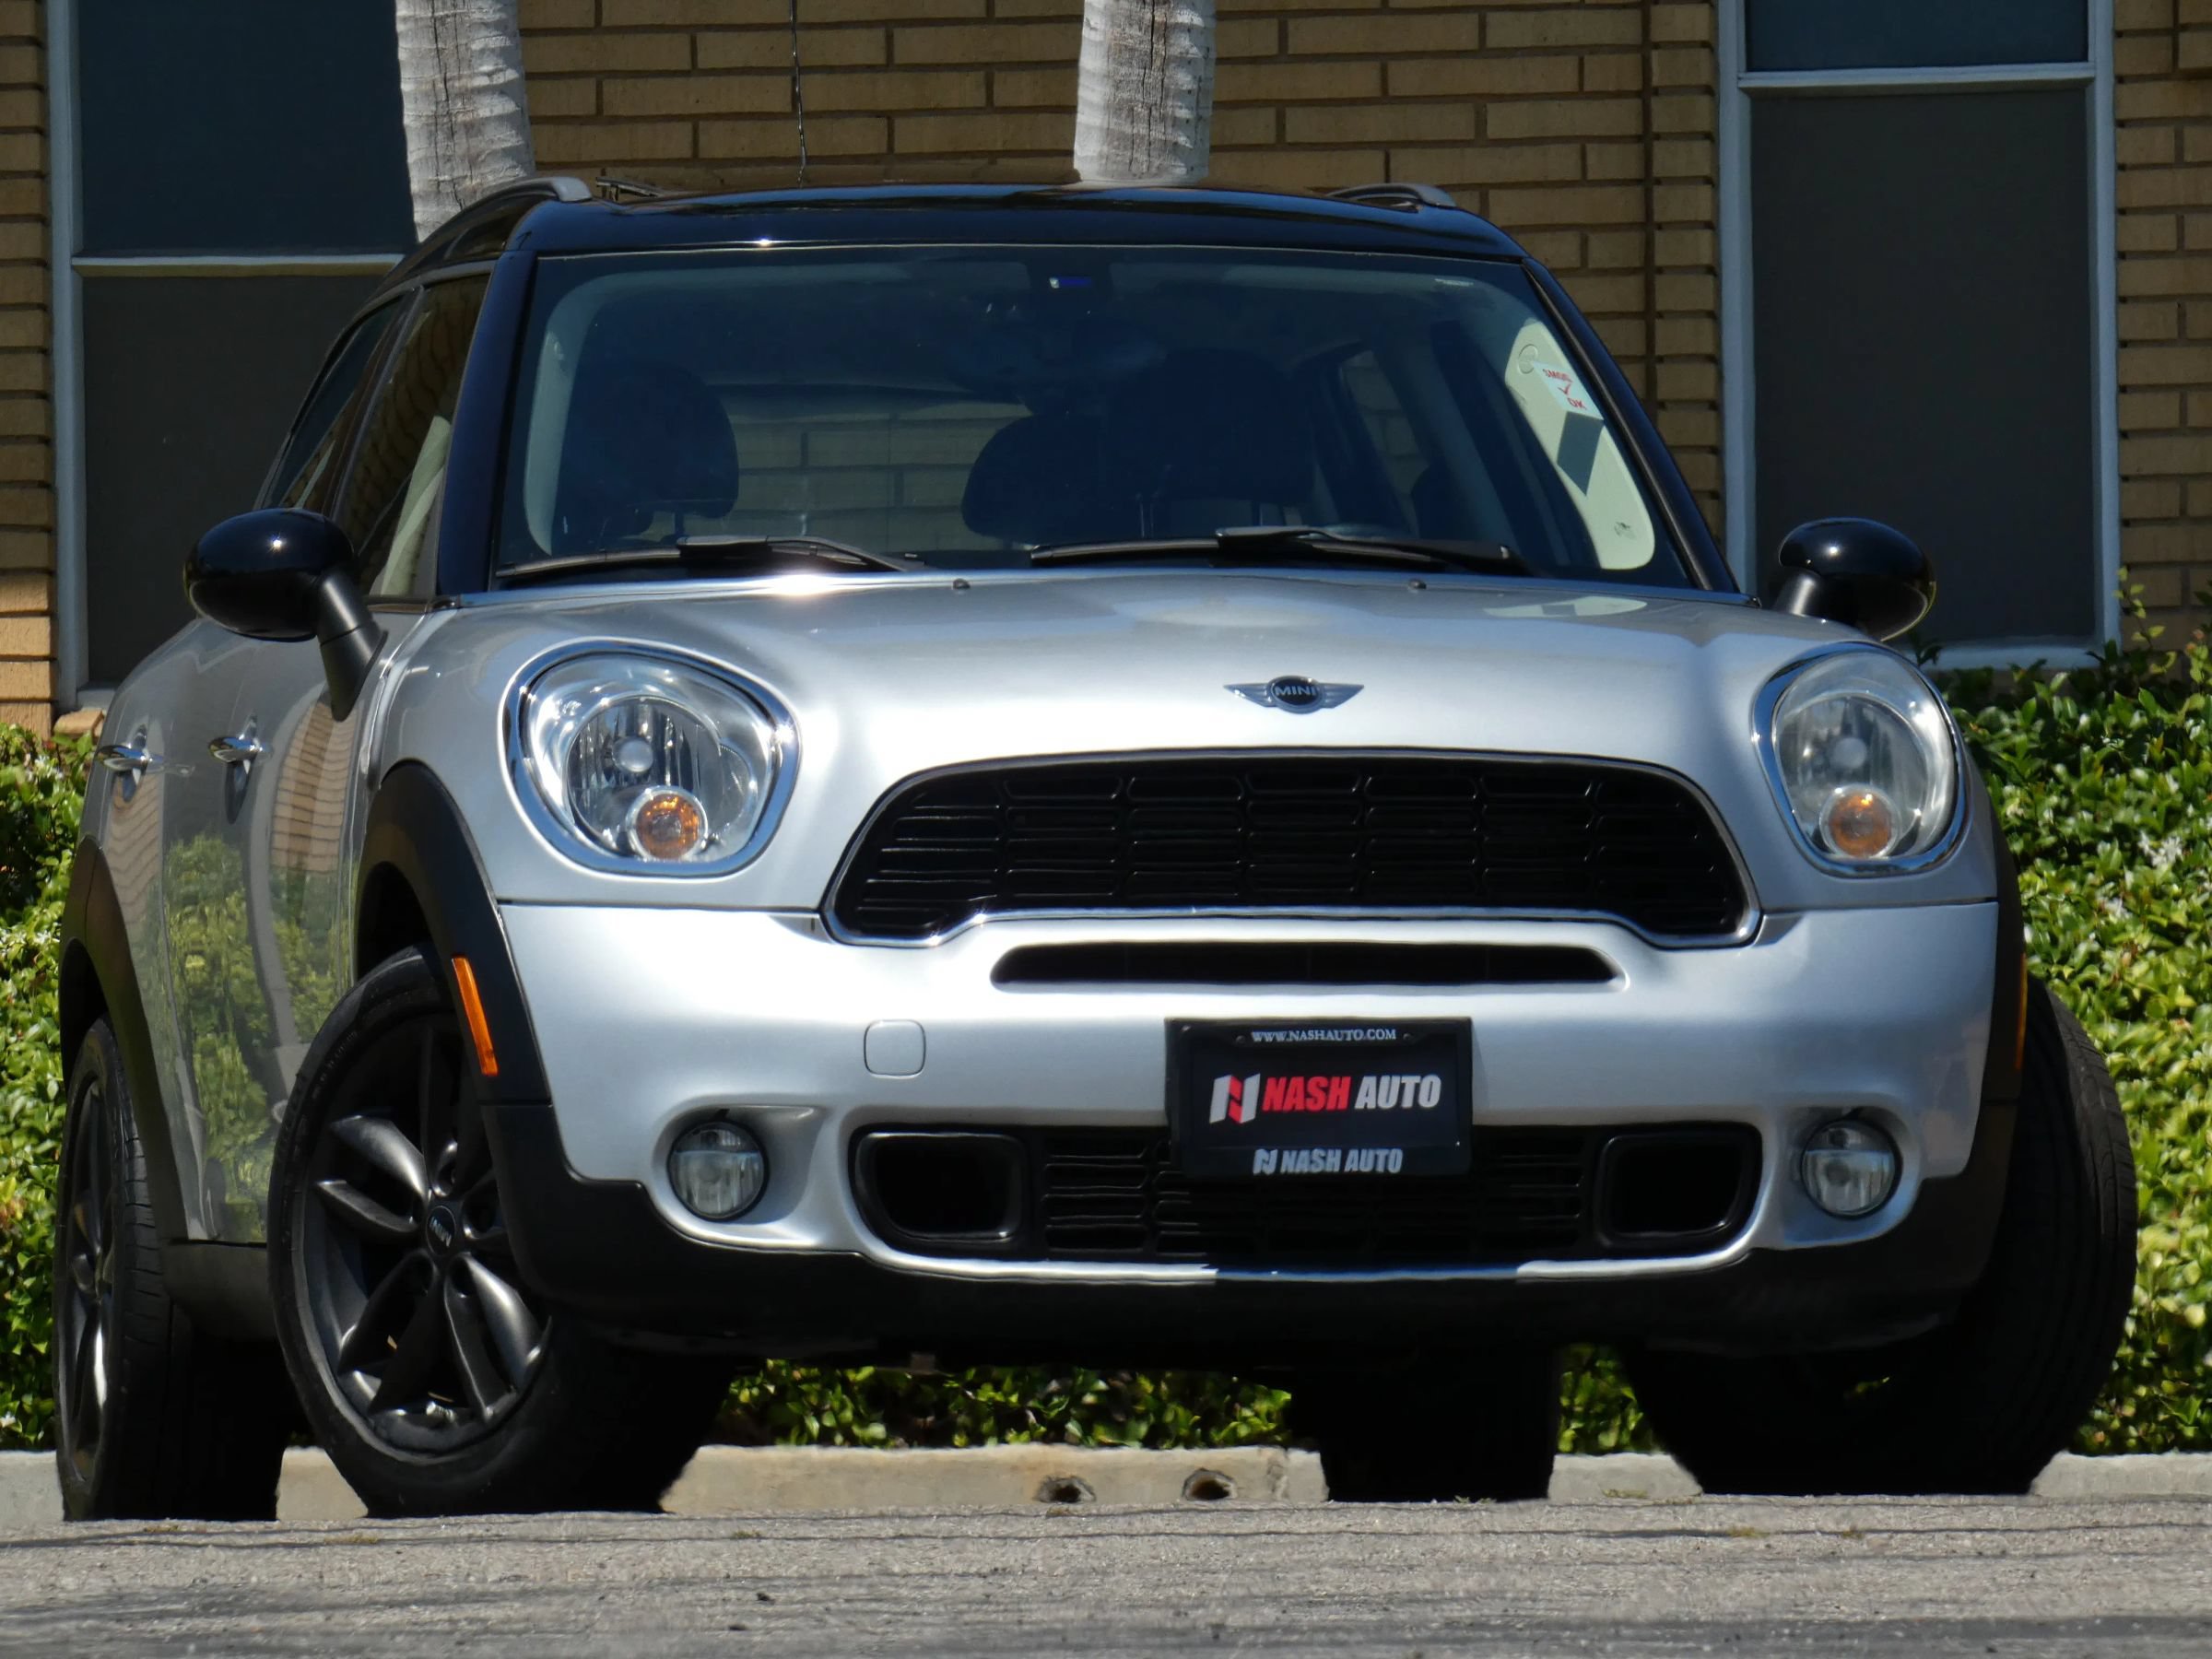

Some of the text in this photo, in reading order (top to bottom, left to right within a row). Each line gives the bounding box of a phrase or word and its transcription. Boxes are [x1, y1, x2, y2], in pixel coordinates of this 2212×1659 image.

[1276, 685, 1316, 696] MINI
[1252, 1029, 1396, 1042] WWW.NASHAUTO.COM
[1262, 1076, 1351, 1112] NASH
[1354, 1074, 1441, 1110] AUTO
[1280, 1149, 1342, 1174] NASH
[1344, 1148, 1404, 1173] AUTO
